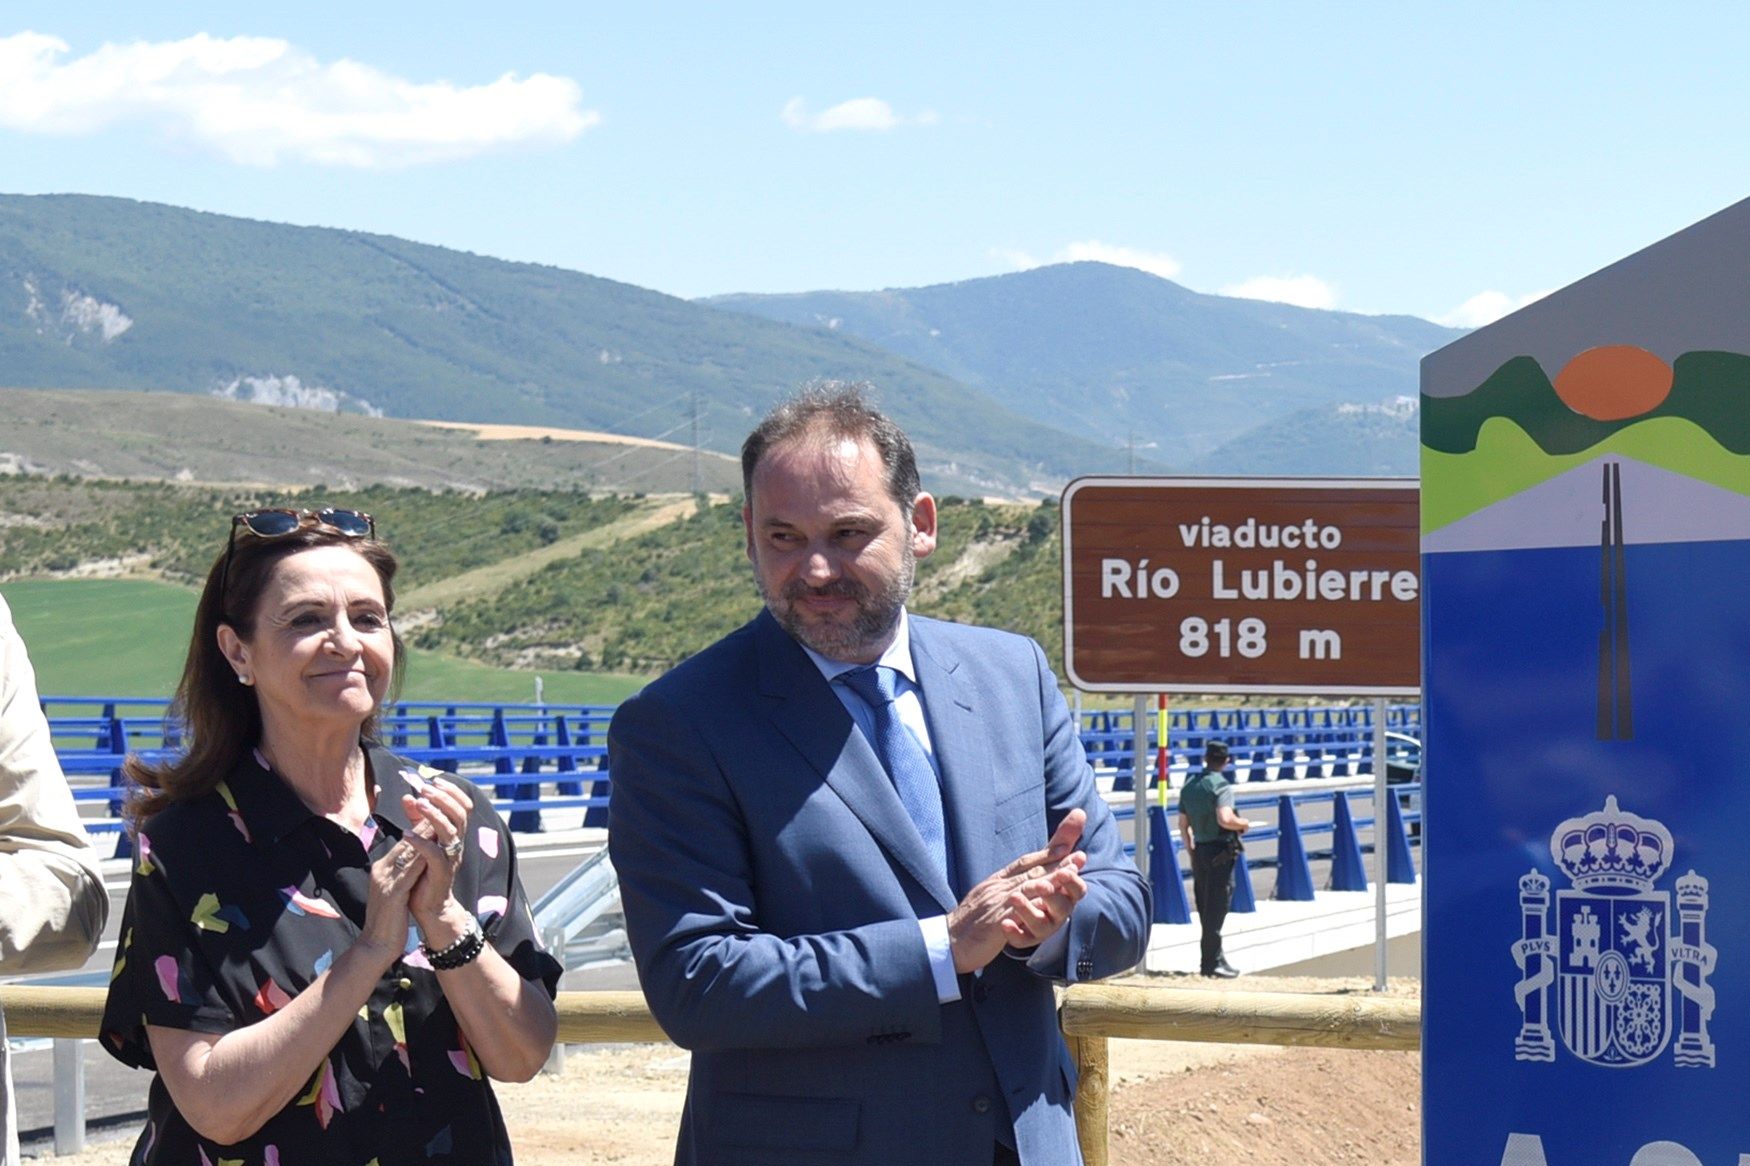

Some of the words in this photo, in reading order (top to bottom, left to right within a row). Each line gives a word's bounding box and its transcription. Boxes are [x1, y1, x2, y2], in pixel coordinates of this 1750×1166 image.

[1179, 516, 1342, 549] viaducto
[1101, 559, 1180, 599] Río
[1212, 560, 1419, 601] Lubierre
[1179, 616, 1268, 659] 818
[1299, 628, 1342, 660] m
